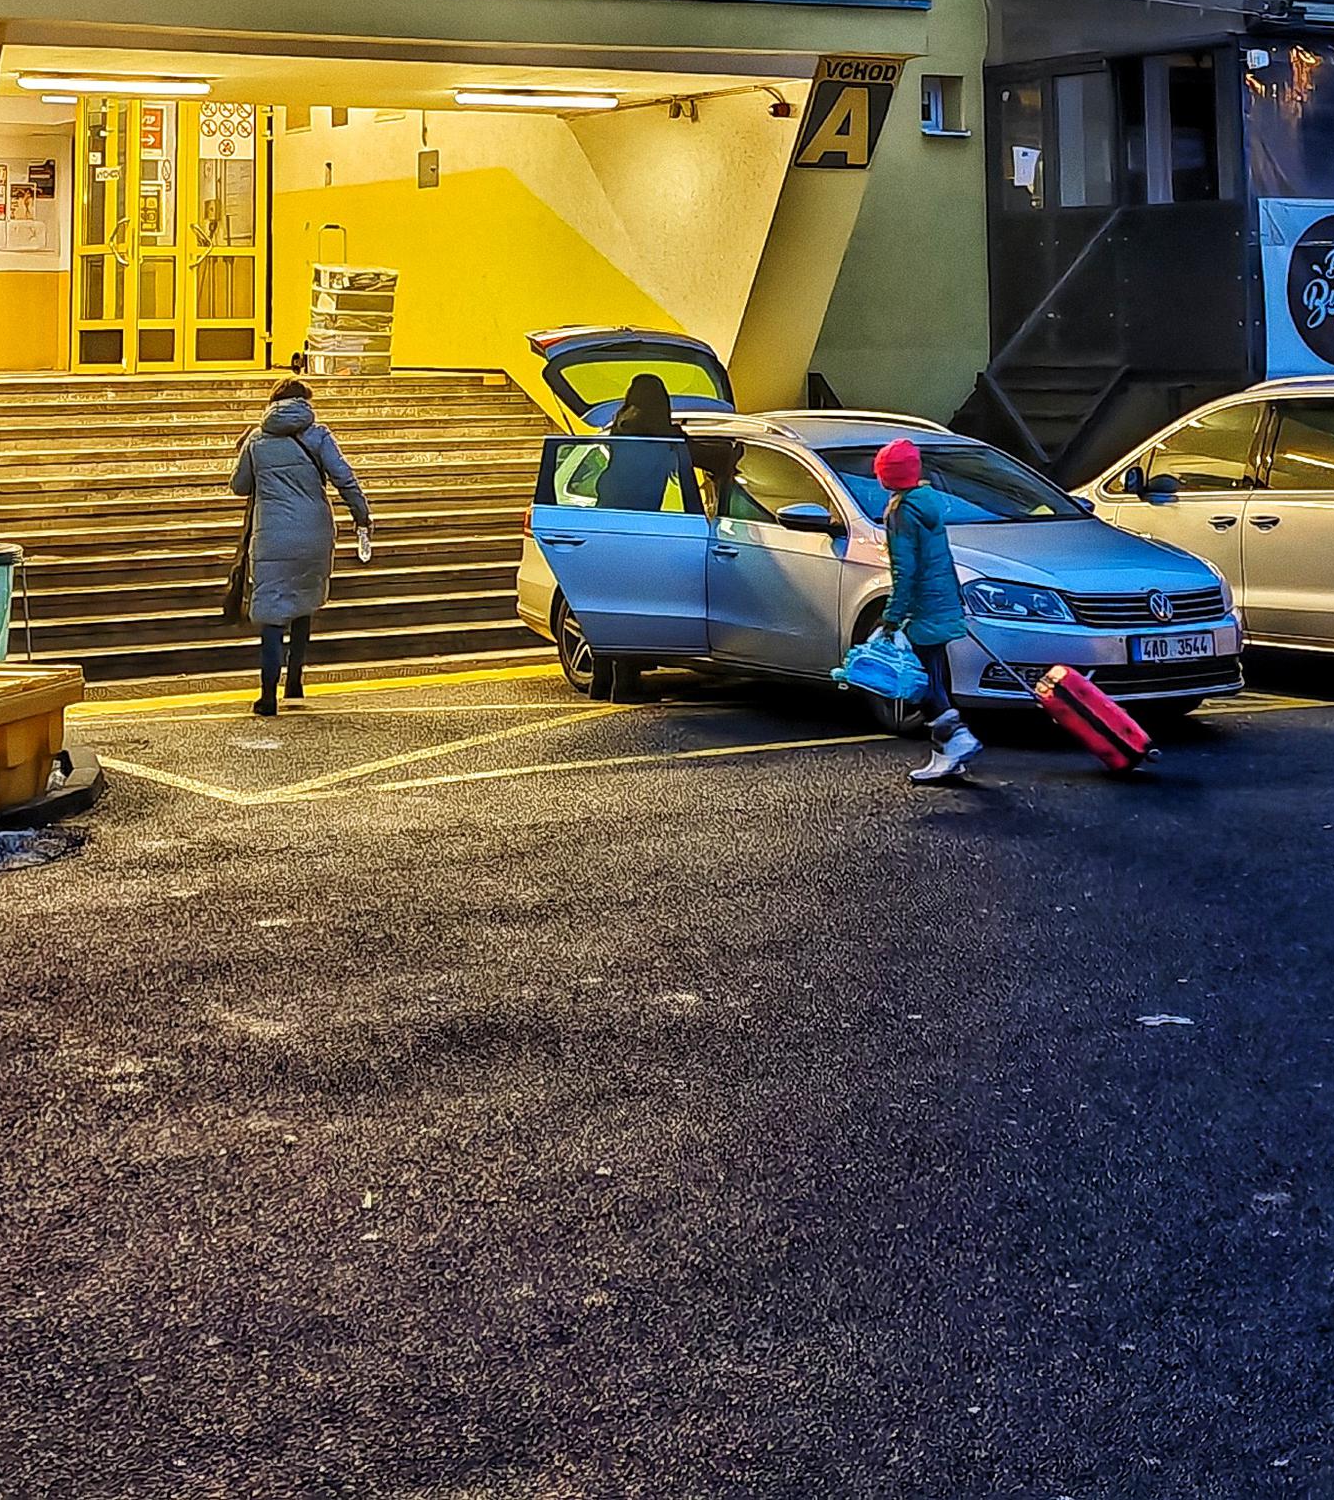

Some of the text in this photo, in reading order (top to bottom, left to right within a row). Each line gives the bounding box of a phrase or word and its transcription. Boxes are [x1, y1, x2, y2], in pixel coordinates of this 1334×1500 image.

[826, 60, 898, 82] VCHOD
[796, 86, 869, 165] A
[1143, 636, 1208, 658] 4AD 3544
